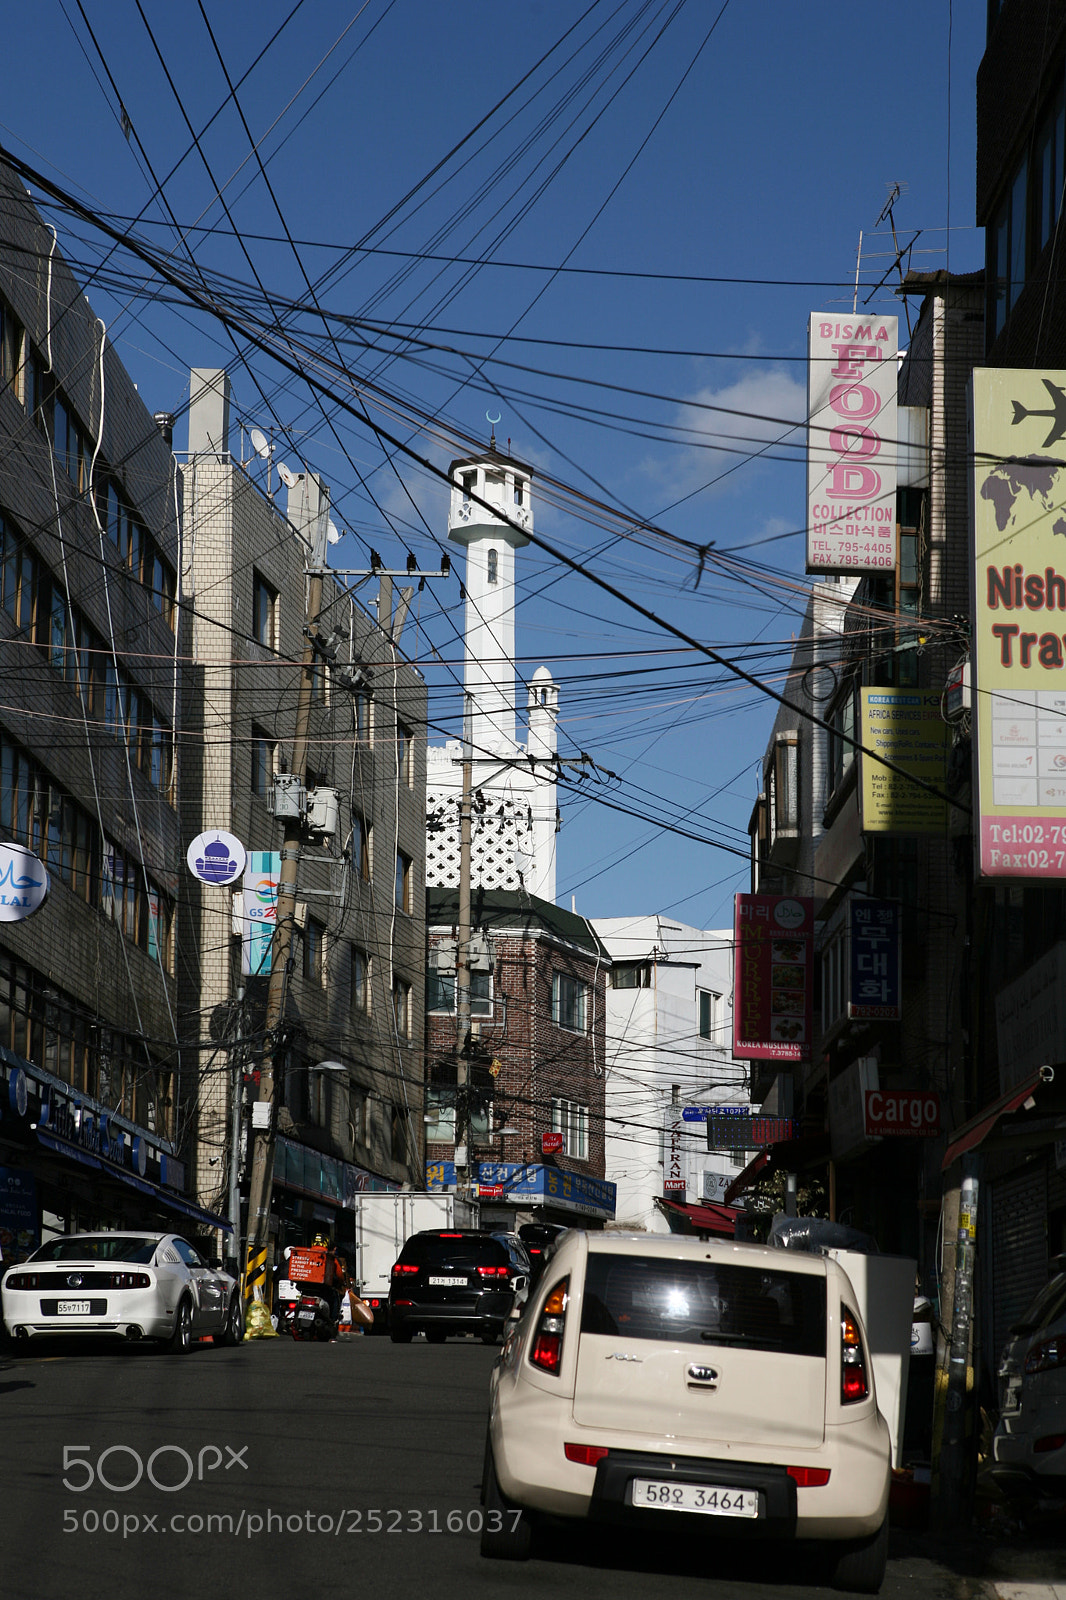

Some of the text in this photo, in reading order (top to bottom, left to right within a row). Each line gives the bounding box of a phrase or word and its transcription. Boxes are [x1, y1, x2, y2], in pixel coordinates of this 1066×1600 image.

[819, 323, 888, 341] BISMA
[826, 343, 882, 500] FOOD
[812, 504, 892, 524] COLLECTION
[813, 523, 891, 538] 비스마식품
[992, 623, 1066, 670] Tra
[869, 709, 891, 720] AFRICA
[892, 710, 921, 721] SERVICES
[740, 904, 769, 922] 마리
[857, 926, 892, 1003] 무대화
[737, 1040, 810, 1051] KOREA MUSLIM FOOD
[868, 1093, 937, 1128] Cargo
[548, 1171, 572, 1198] 동원
[665, 1181, 684, 1189] Mart
[646, 1484, 744, 1511] 58오 3464
